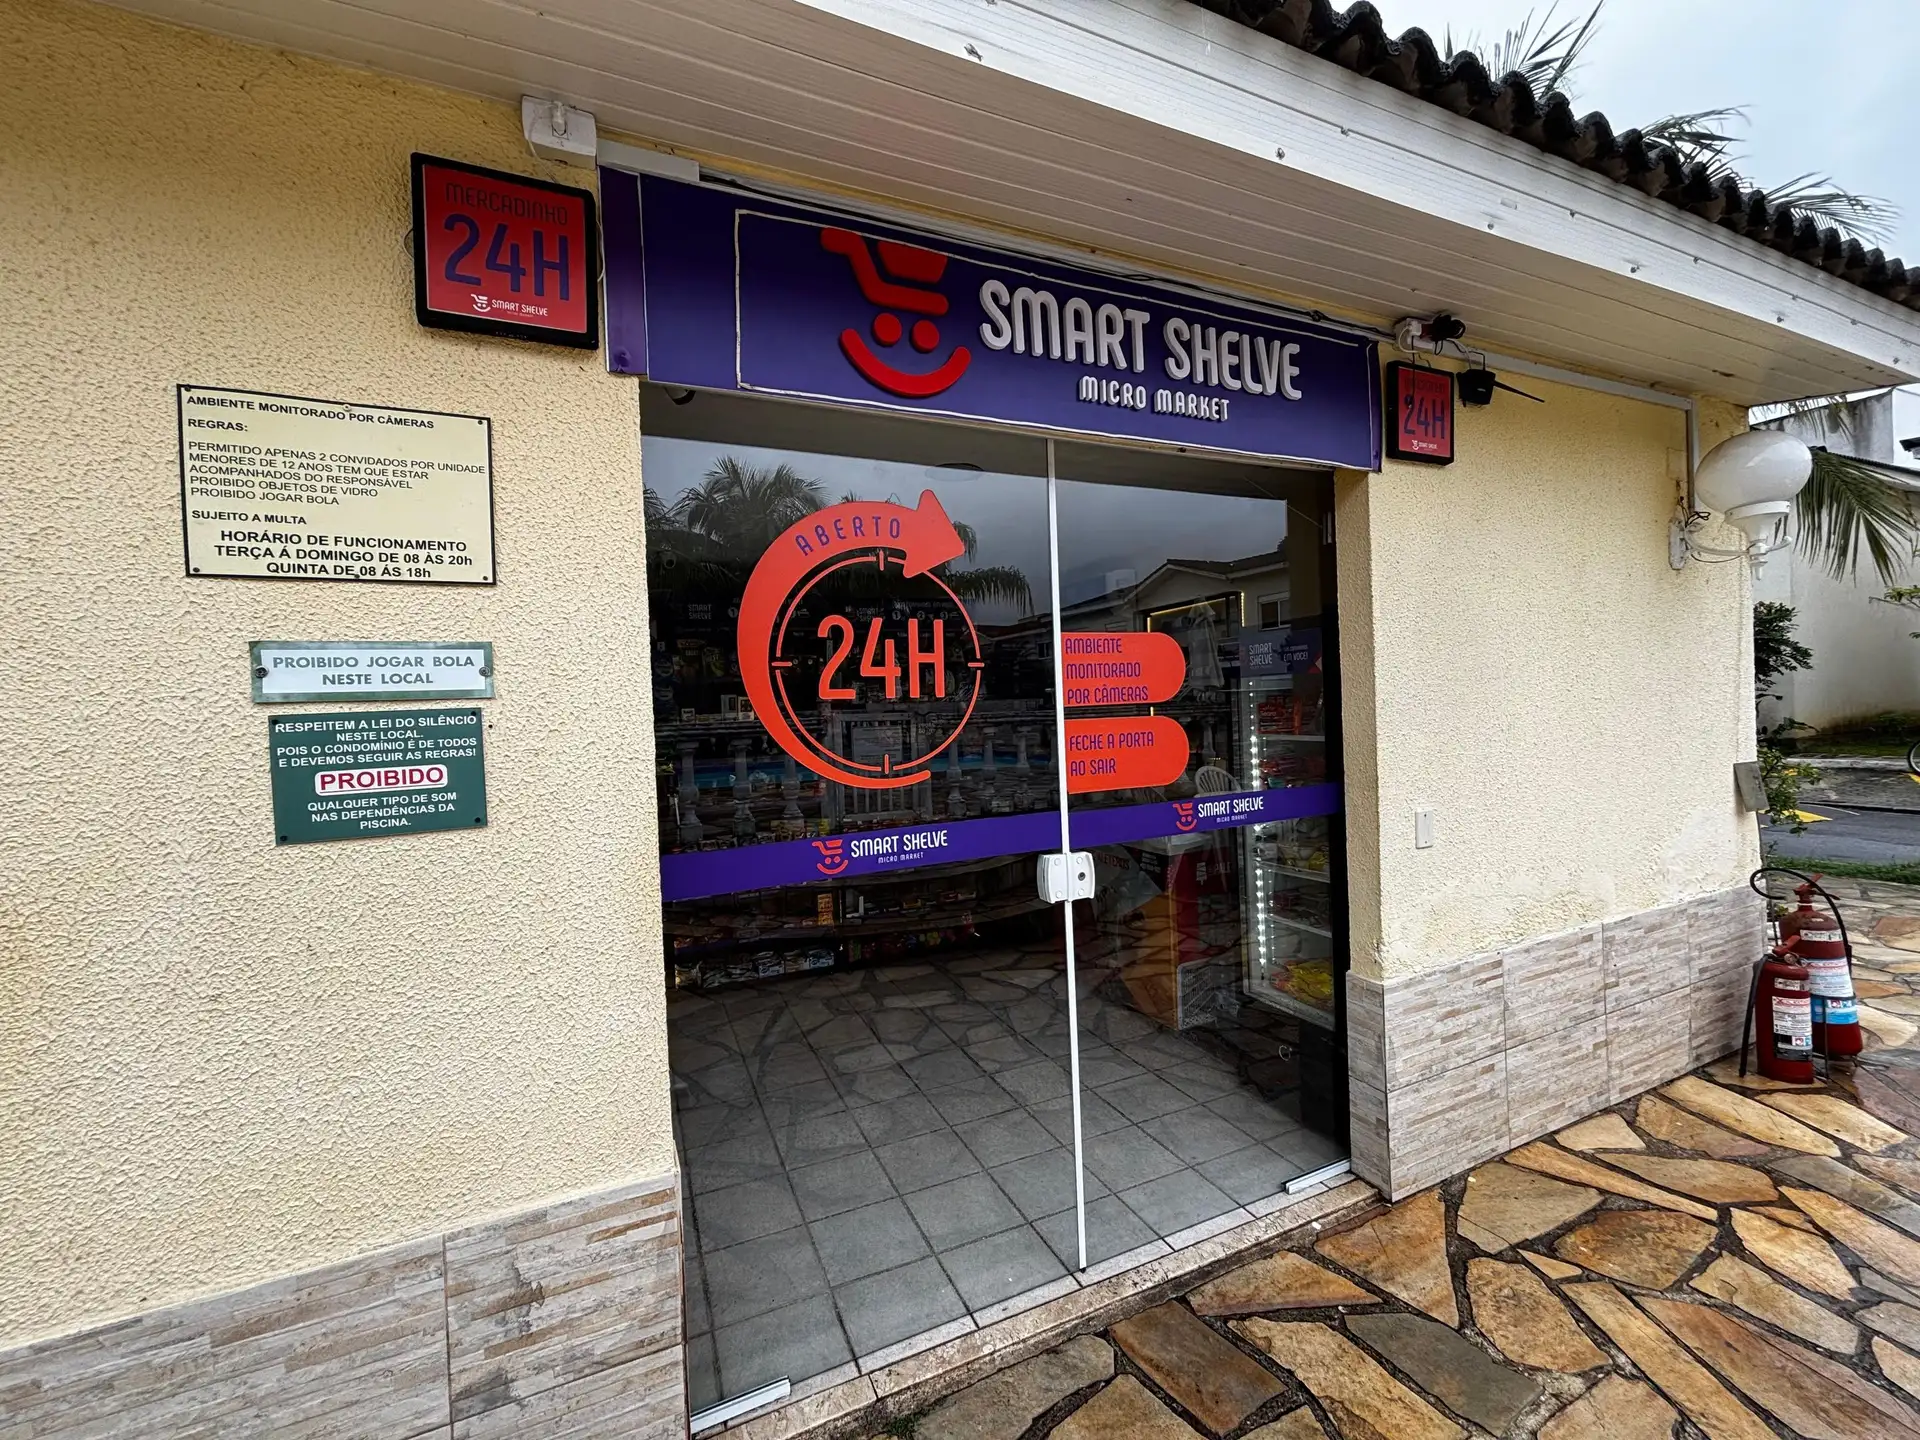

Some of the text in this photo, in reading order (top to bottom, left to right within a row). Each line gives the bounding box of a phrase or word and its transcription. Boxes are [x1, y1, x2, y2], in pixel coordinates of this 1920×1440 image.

[446, 183, 567, 225] MERCADINHO
[444, 214, 569, 301] 24H
[492, 300, 519, 313] SMART
[522, 305, 548, 316] SHELVE
[979, 279, 1302, 400] SMART SHELVE
[1079, 376, 1229, 421] MICRO MARKET
[187, 396, 434, 428] AMBIENTE MONITORADO POR CÂMERAS
[1404, 394, 1445, 439] 24H
[188, 419, 248, 432] REGRAS:
[189, 442, 485, 474] PERMITIDO APENAS 2 CONVIDADOS POR UNIDADE
[190, 453, 428, 479] MENORES DE 12 ANOS TEM QUE ESTAR
[190, 465, 412, 489] ACOMPANHADOS DO RESPONSÁVEL
[191, 476, 377, 496] PROIBIDO OBJETOS DE VIDRO
[191, 488, 339, 505] PROIBIDO JOGAR BOLA
[192, 510, 307, 525] SUJEITO A MULTA
[221, 530, 466, 552] HORÁRIO DE FUNCIONAMENTO
[795, 516, 900, 556] ABERTO
[214, 545, 273, 560] TERÇA
[296, 550, 374, 562] DOMINGO
[379, 552, 399, 563] DE
[404, 553, 419, 563] 08
[448, 555, 472, 565] 20h
[267, 562, 329, 575] QUINTA
[334, 565, 354, 576] DE
[360, 566, 376, 576] 08
[407, 568, 431, 578] 18h
[1065, 638, 1122, 654] AMBIENTE
[1249, 643, 1272, 655] SMART
[273, 656, 474, 668] PROIBIDO JOGAR BOLA
[818, 615, 945, 699] 24H
[1250, 654, 1272, 665] SHELVE
[322, 673, 433, 685] NESTE LOCAL
[1067, 662, 1140, 679] MONITORADO
[1068, 684, 1148, 704] POR CÂMERAS
[275, 715, 476, 733] RESPEITEM A LEI DO SILÊNCIO
[337, 732, 377, 741] NESTE
[1070, 731, 1153, 751] FECHE A PORTA
[277, 738, 476, 756] POIS O CONDOMÍNIO É DE TODOS
[279, 748, 476, 767] E DEVEMOS SEGUIR AS REGRAS!
[1071, 758, 1116, 776] AO SAIR
[320, 767, 444, 790] PROIBIDO
[307, 792, 457, 811] QUALQUER TIPO DE SOM
[1198, 797, 1264, 817] SMART SHELVE
[312, 803, 454, 822] NAS DEPENDÊNCIAS DA
[360, 818, 410, 829] PISCINA.
[851, 830, 948, 857] SMART SHELVE
[900, 852, 924, 860] MARKET
